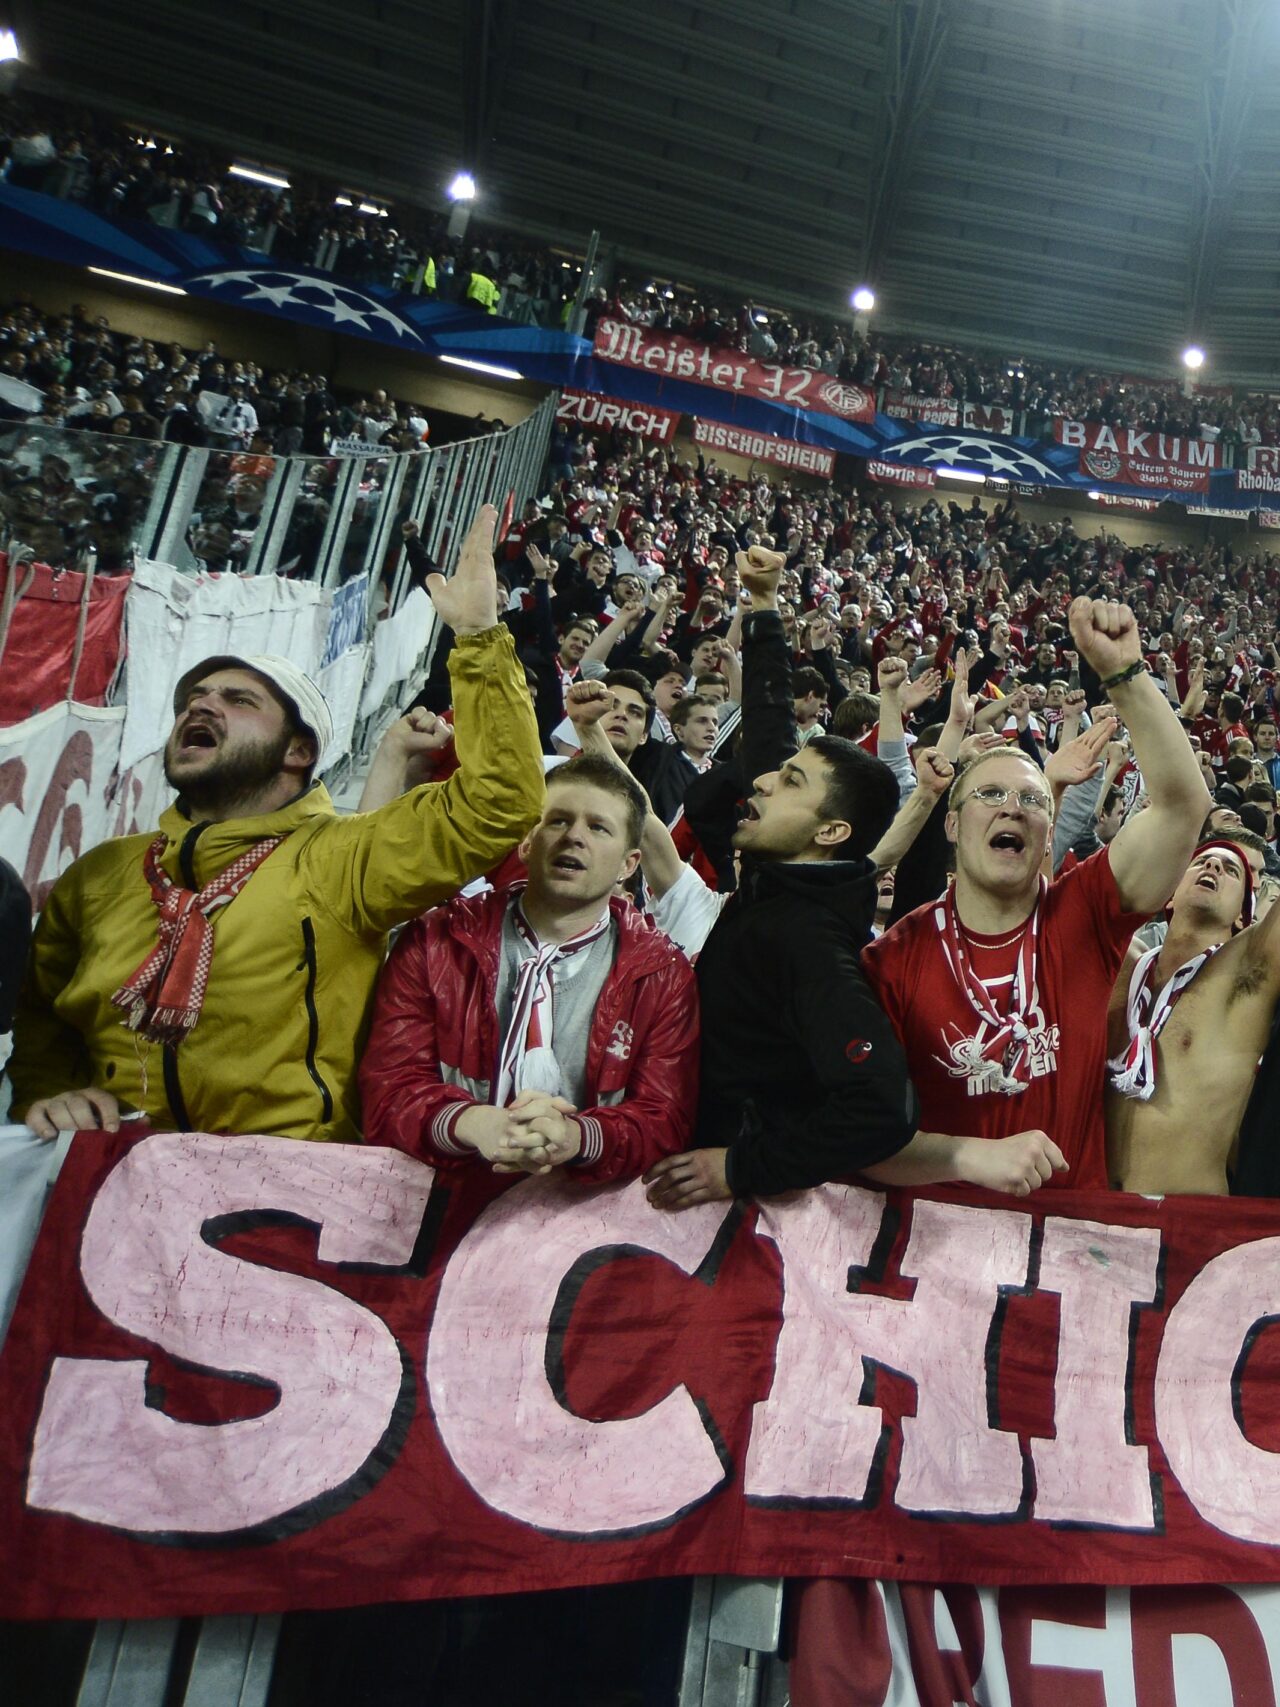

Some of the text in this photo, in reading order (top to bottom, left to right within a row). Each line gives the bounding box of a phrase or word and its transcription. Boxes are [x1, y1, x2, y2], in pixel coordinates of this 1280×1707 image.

[597, 320, 756, 391] Meister
[556, 390, 671, 439] ZÜRICH
[693, 418, 832, 475] BISCHOFSHEIM
[1062, 420, 1215, 467] BAKUM
[1172, 478, 1194, 488] 1997
